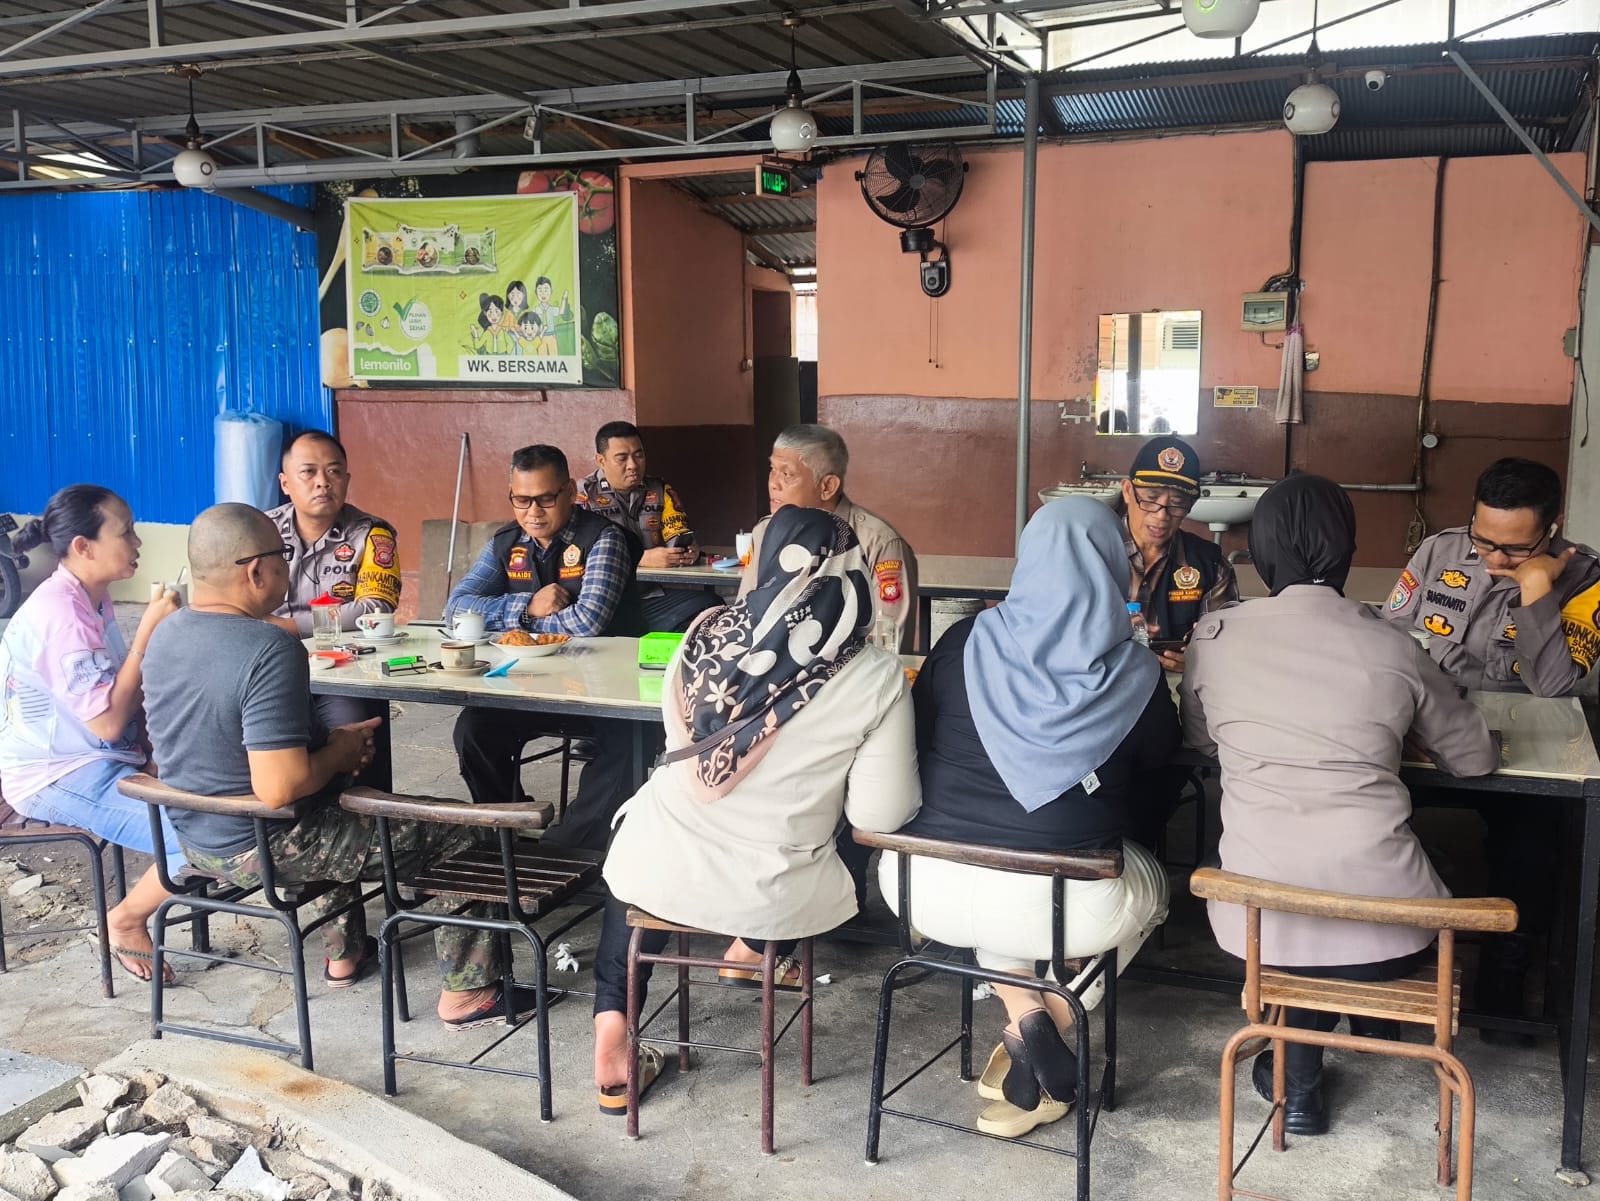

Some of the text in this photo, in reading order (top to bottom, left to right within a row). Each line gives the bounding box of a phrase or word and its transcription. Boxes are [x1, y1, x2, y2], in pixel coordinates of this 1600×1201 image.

[360, 357, 412, 371] lemonilo
[467, 360, 568, 373] WK. BERSAMA
